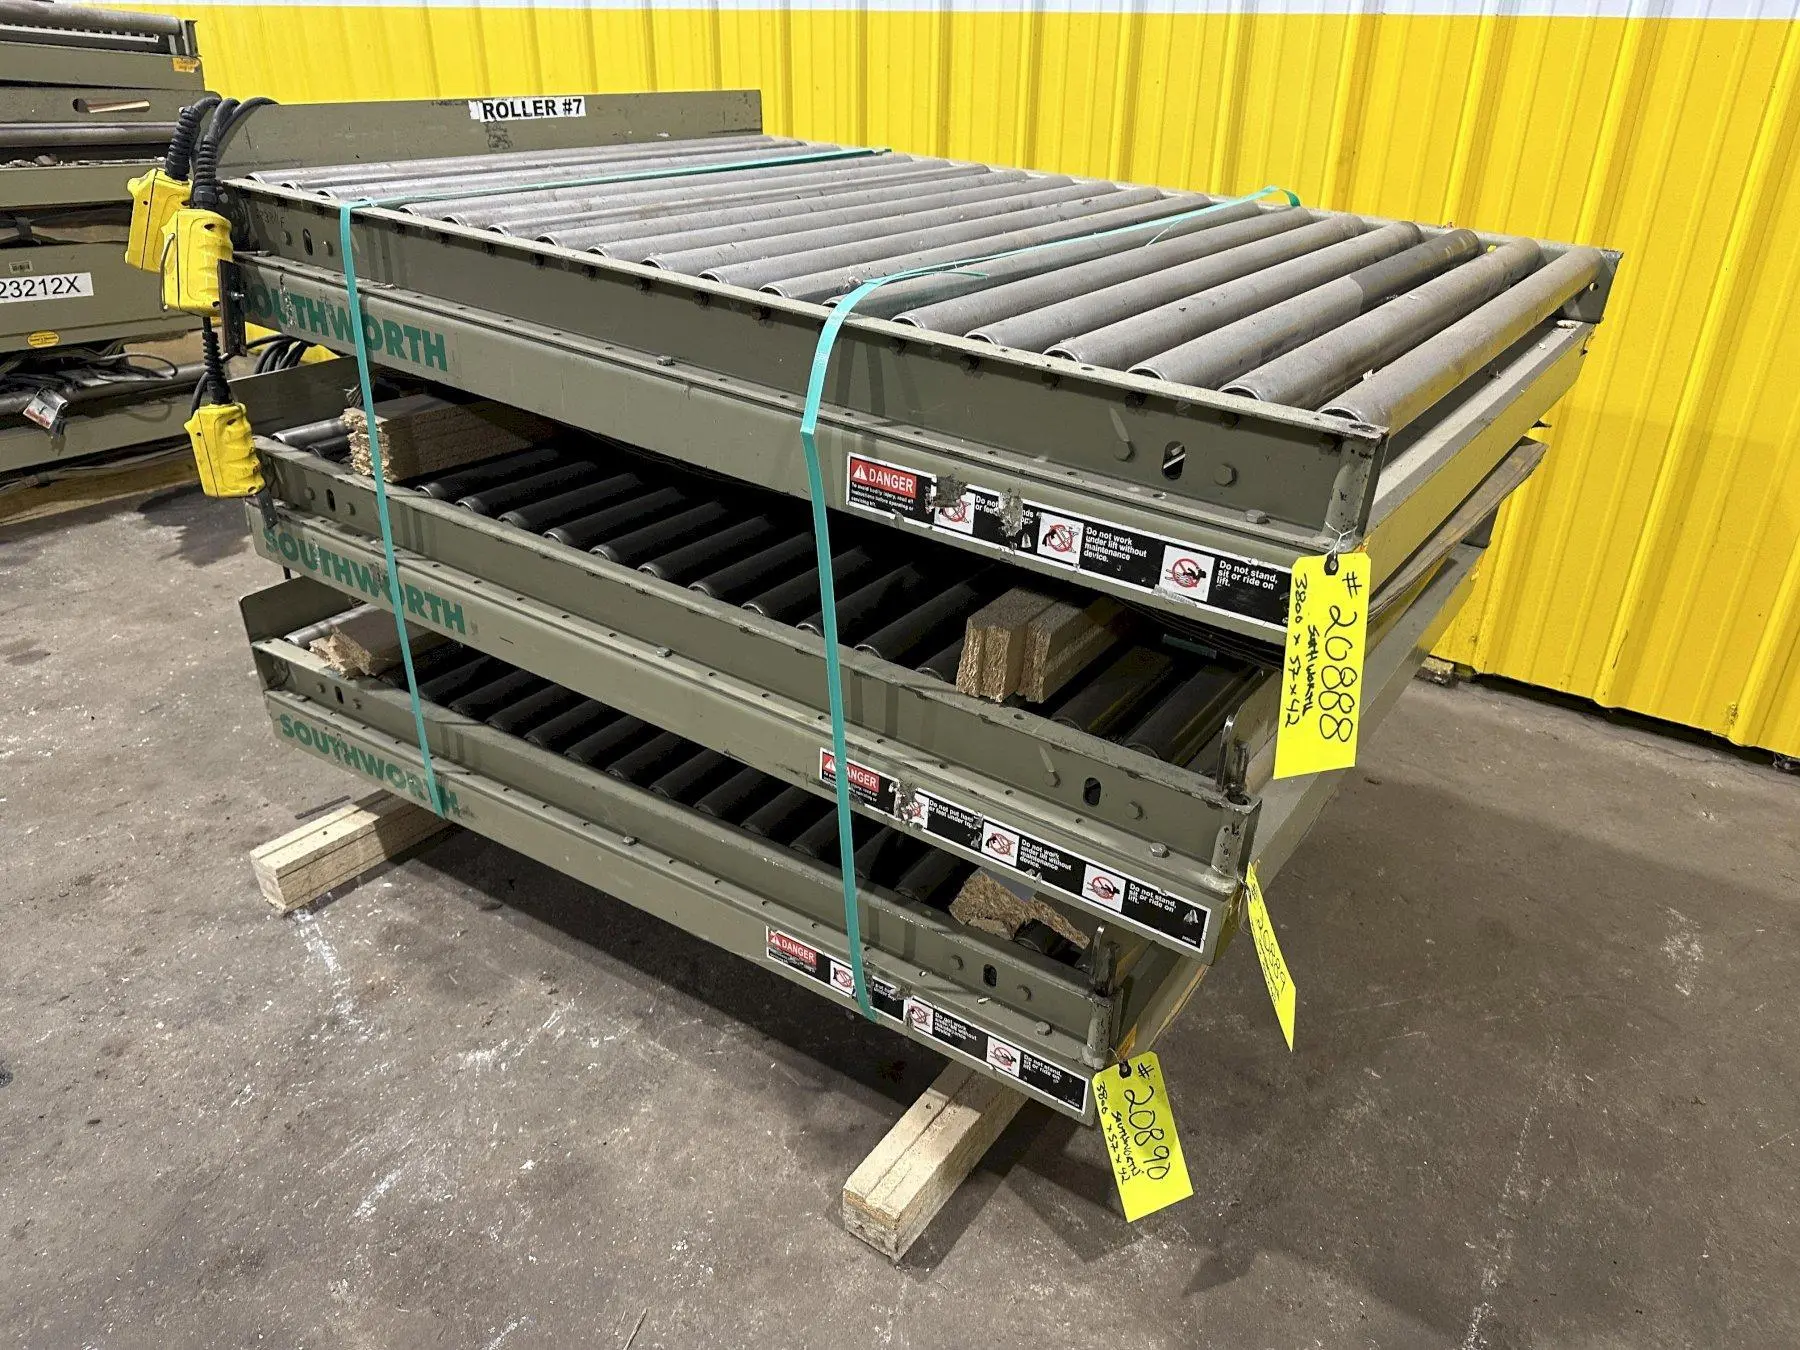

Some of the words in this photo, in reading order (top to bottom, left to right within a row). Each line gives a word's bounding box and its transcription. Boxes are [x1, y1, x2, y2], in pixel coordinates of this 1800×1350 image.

[482, 100, 557, 120] ROLLER
[562, 98, 583, 116] #7
[244, 284, 448, 372] OUTHWORTH
[869, 468, 914, 494] DANGER
[975, 495, 986, 505] Do
[1086, 526, 1097, 536] Do
[1099, 531, 1112, 540] not
[1113, 535, 1132, 546] work
[1086, 535, 1107, 546] under
[1108, 540, 1118, 550] lift
[1119, 544, 1147, 558] without
[1083, 550, 1109, 563] device.
[1085, 543, 1131, 561] maintenance
[1216, 576, 1230, 587] lift.
[1218, 569, 1229, 578] sit
[1242, 575, 1260, 586] ride
[1262, 581, 1274, 590] on
[1220, 560, 1232, 570] Do
[1233, 566, 1248, 575] not
[1250, 570, 1278, 584] stand,
[1318, 605, 1358, 743] 20888
[846, 766, 877, 789] ANGER
[1021, 839, 1031, 848] Do
[1032, 844, 1043, 853] not
[1020, 851, 1059, 871] maintenance
[1049, 856, 1072, 871] without
[1130, 883, 1140, 892] Do
[1141, 889, 1154, 898] not
[1155, 894, 1177, 909] stand,
[1149, 898, 1163, 908] ride
[1164, 904, 1174, 913] on
[781, 940, 814, 963] DANGER
[1124, 1085, 1171, 1181] 20890
